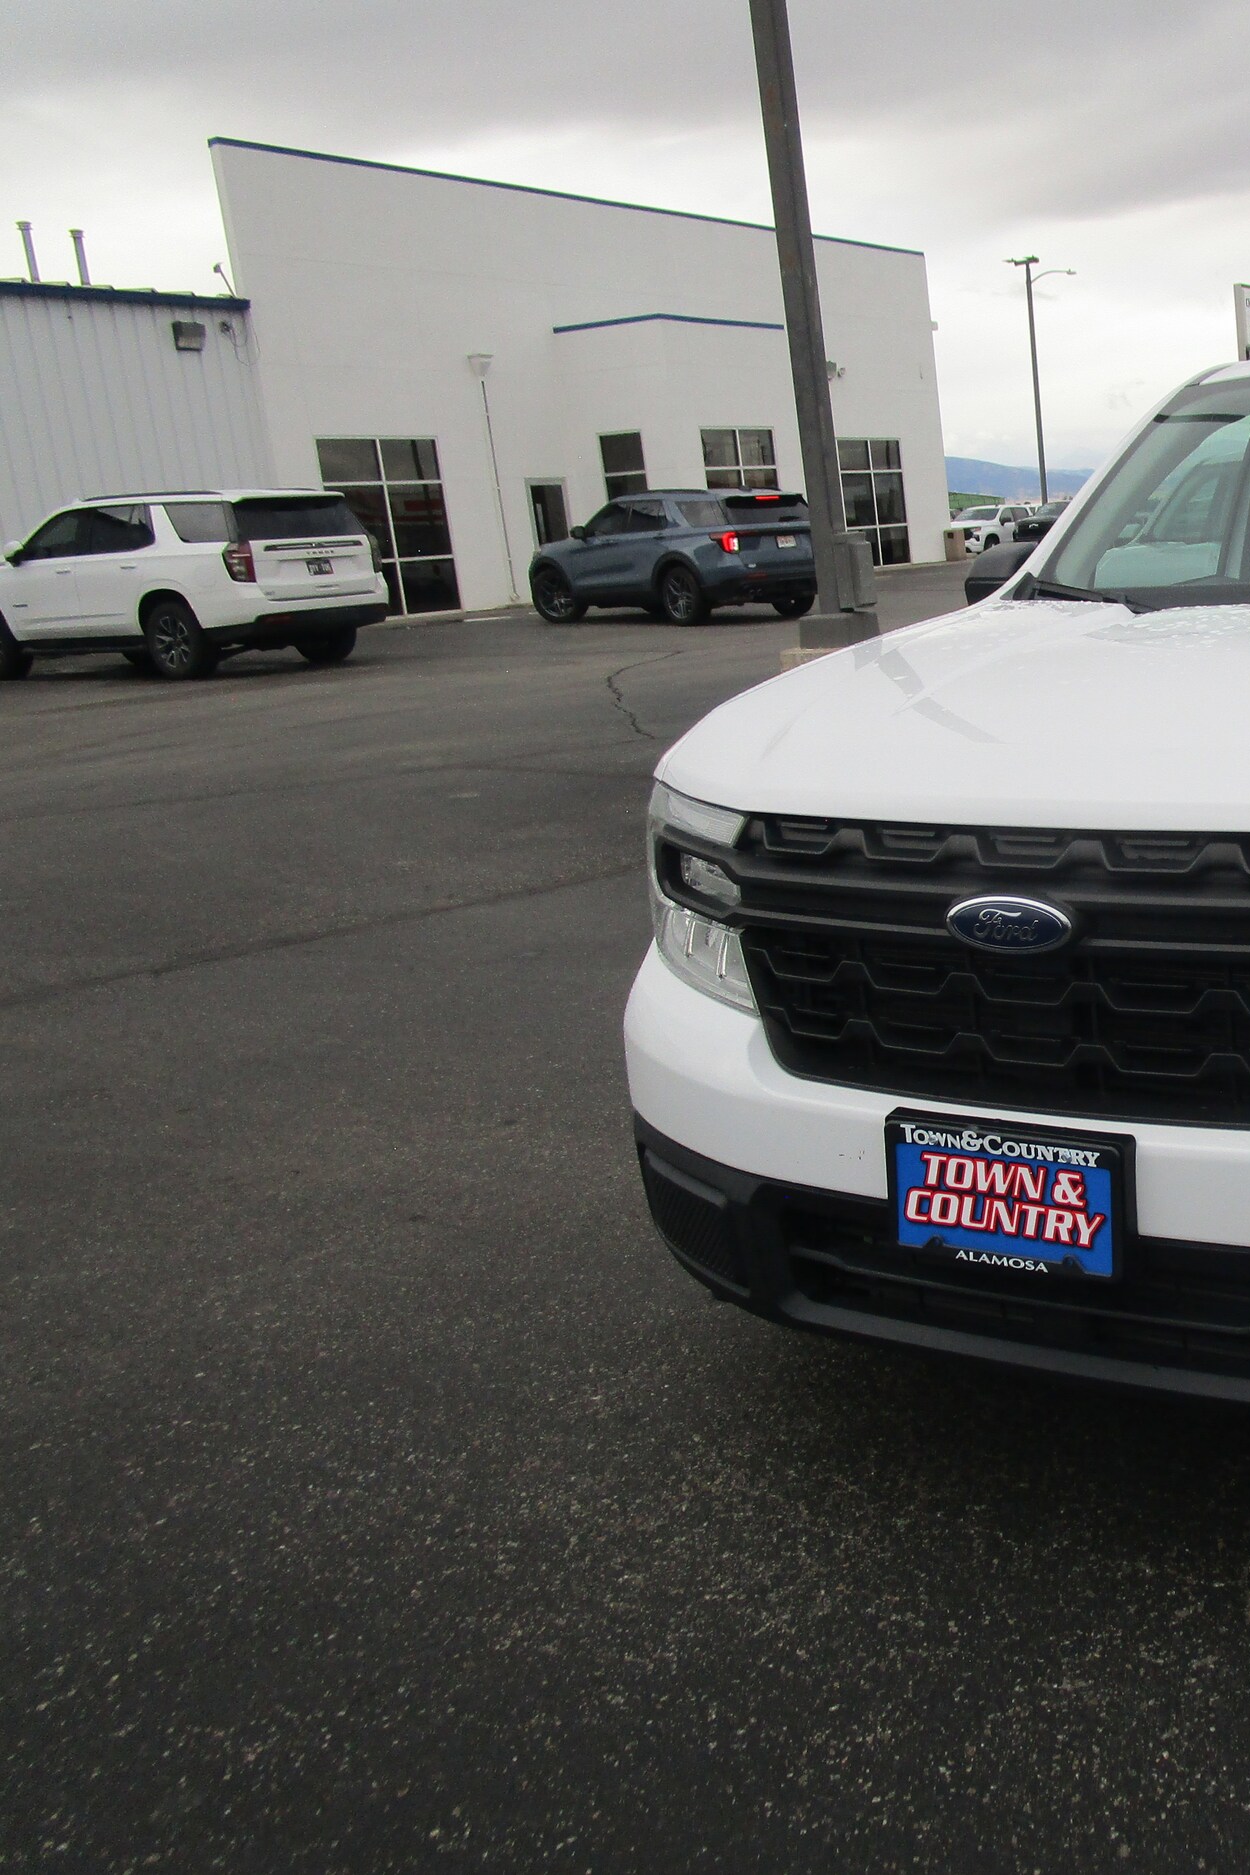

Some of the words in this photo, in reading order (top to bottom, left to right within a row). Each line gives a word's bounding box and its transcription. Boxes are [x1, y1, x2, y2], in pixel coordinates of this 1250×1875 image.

[922, 1153, 1046, 1201] TOWN
[1052, 1169, 1087, 1208] &
[905, 1188, 1105, 1248] COUNTRY
[955, 1250, 1049, 1273] ALAMOSA
